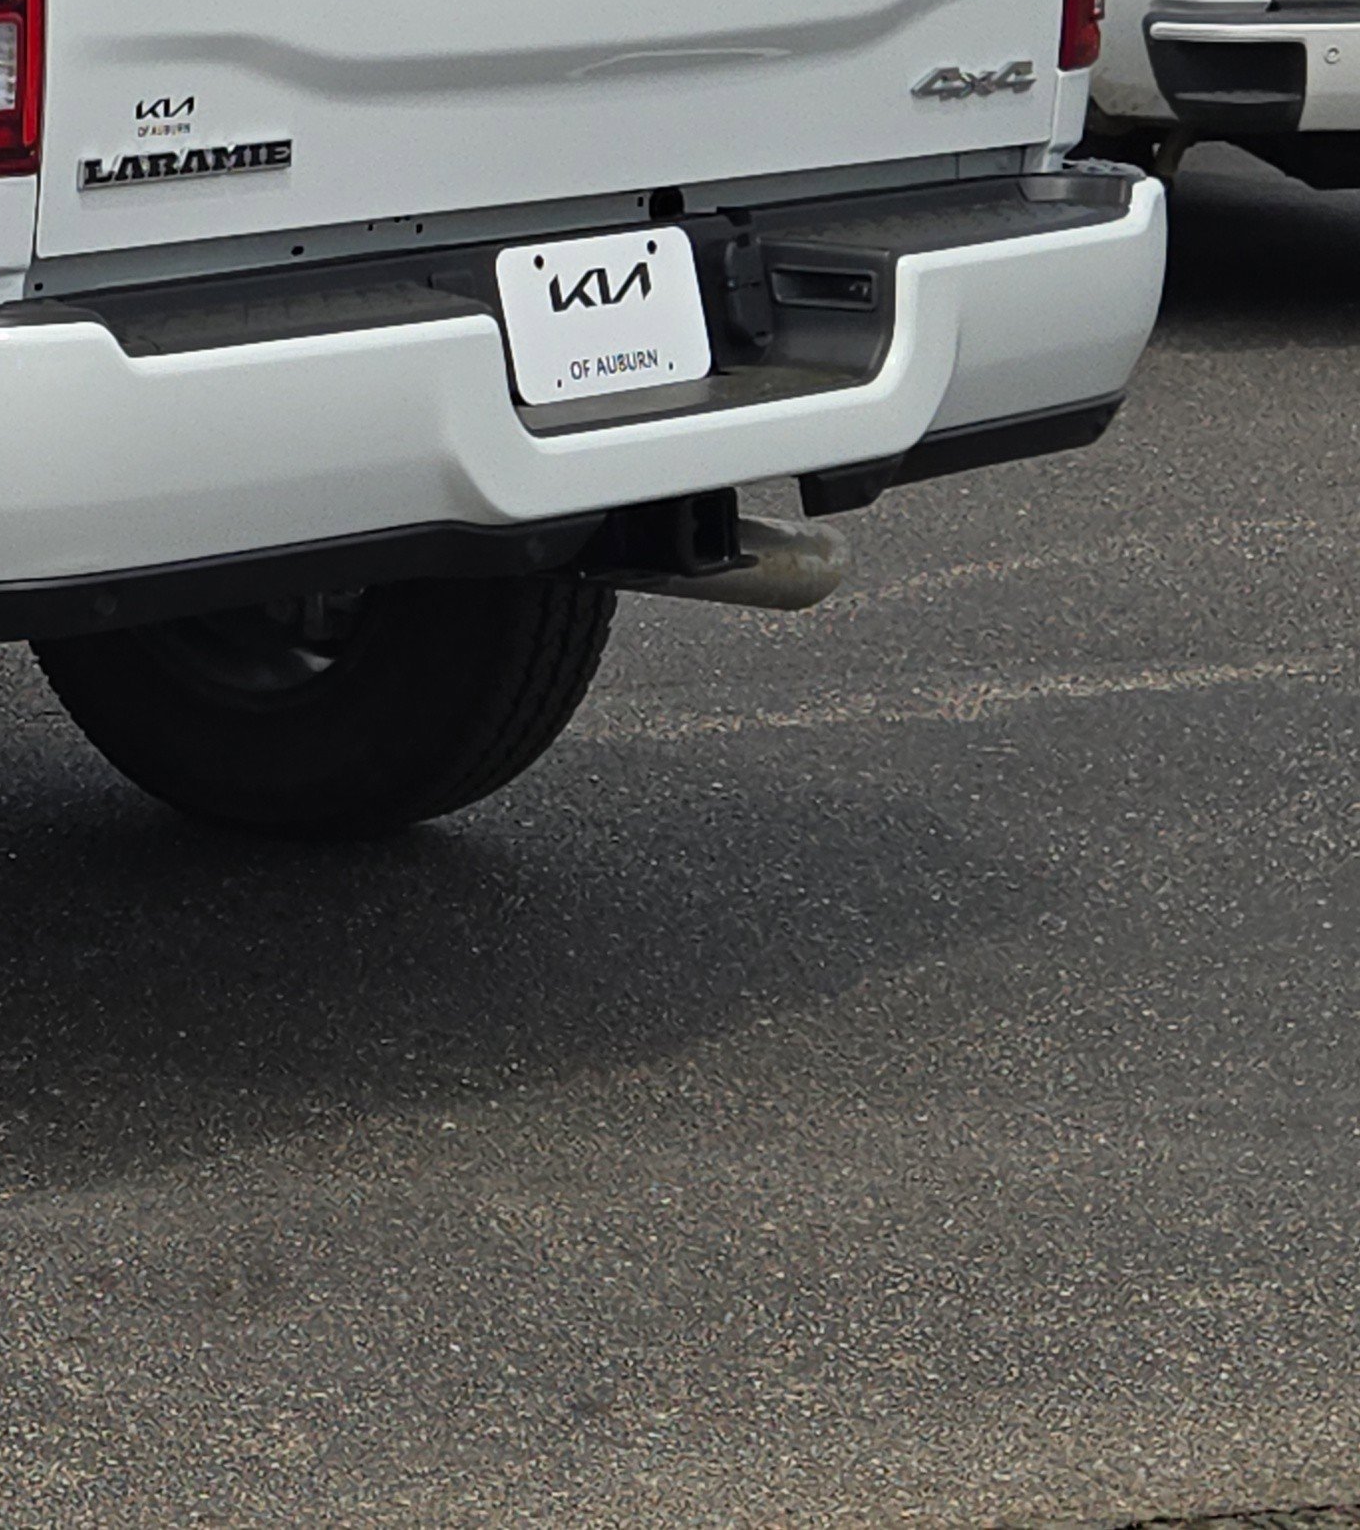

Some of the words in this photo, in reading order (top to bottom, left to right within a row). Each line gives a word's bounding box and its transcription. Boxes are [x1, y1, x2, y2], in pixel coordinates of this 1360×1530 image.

[135, 95, 195, 120] KIA
[151, 122, 191, 137] AUBURN
[81, 139, 292, 186] LARAMIE
[549, 261, 652, 313] KIA
[569, 360, 591, 380] OF
[596, 348, 659, 377] AUBURN
